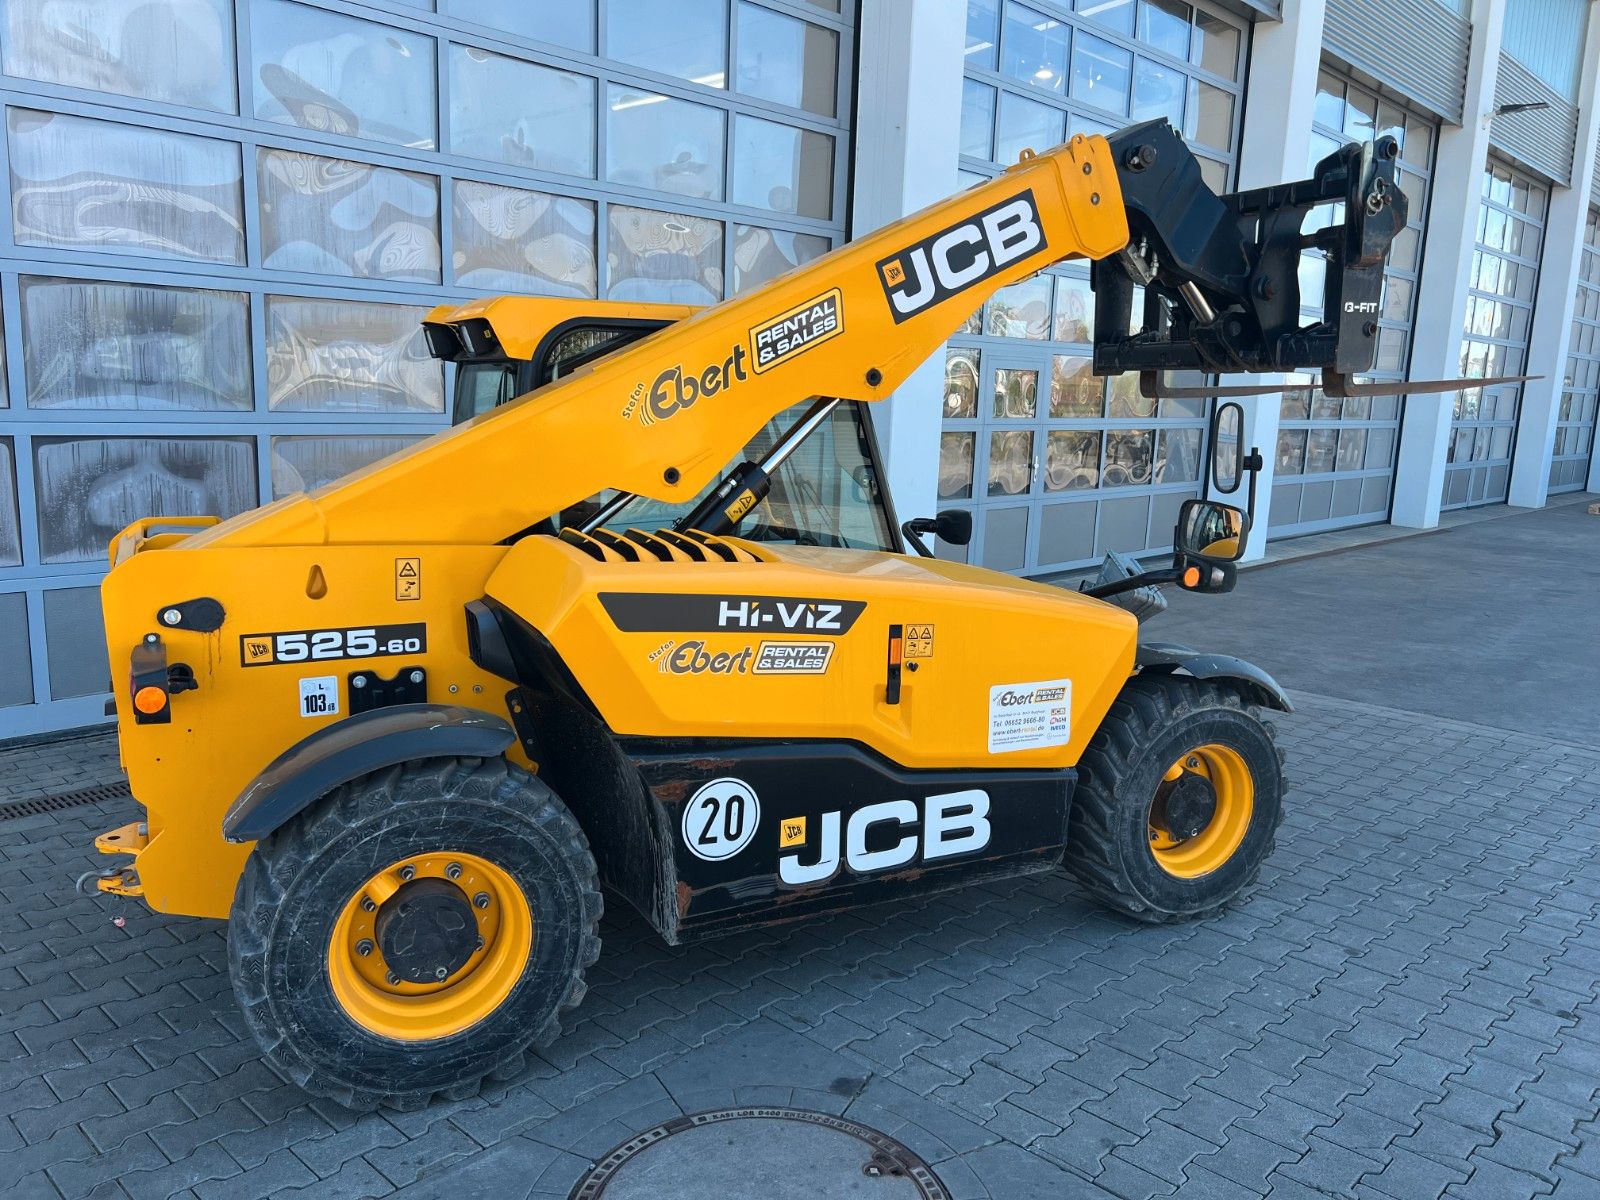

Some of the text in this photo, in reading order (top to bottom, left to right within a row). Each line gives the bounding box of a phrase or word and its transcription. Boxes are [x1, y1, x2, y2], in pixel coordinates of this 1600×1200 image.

[891, 200, 1041, 314] JCB
[757, 301, 835, 348] RENTAL
[759, 315, 837, 364] & SALES
[649, 344, 747, 420] Ebert
[622, 382, 646, 419] Stefan
[249, 643, 269, 658] JCB
[276, 629, 421, 662] 525-60
[648, 640, 675, 662] Stefan
[669, 640, 753, 674] Ebert
[763, 647, 826, 658] RENTAL
[759, 658, 824, 669] & SALES
[304, 694, 327, 714] 103
[1001, 690, 1034, 706] Ebert
[698, 795, 745, 846] 20
[779, 789, 991, 884] JCB
[784, 824, 803, 841] JCB
[712, 1112, 734, 1120] KASI
